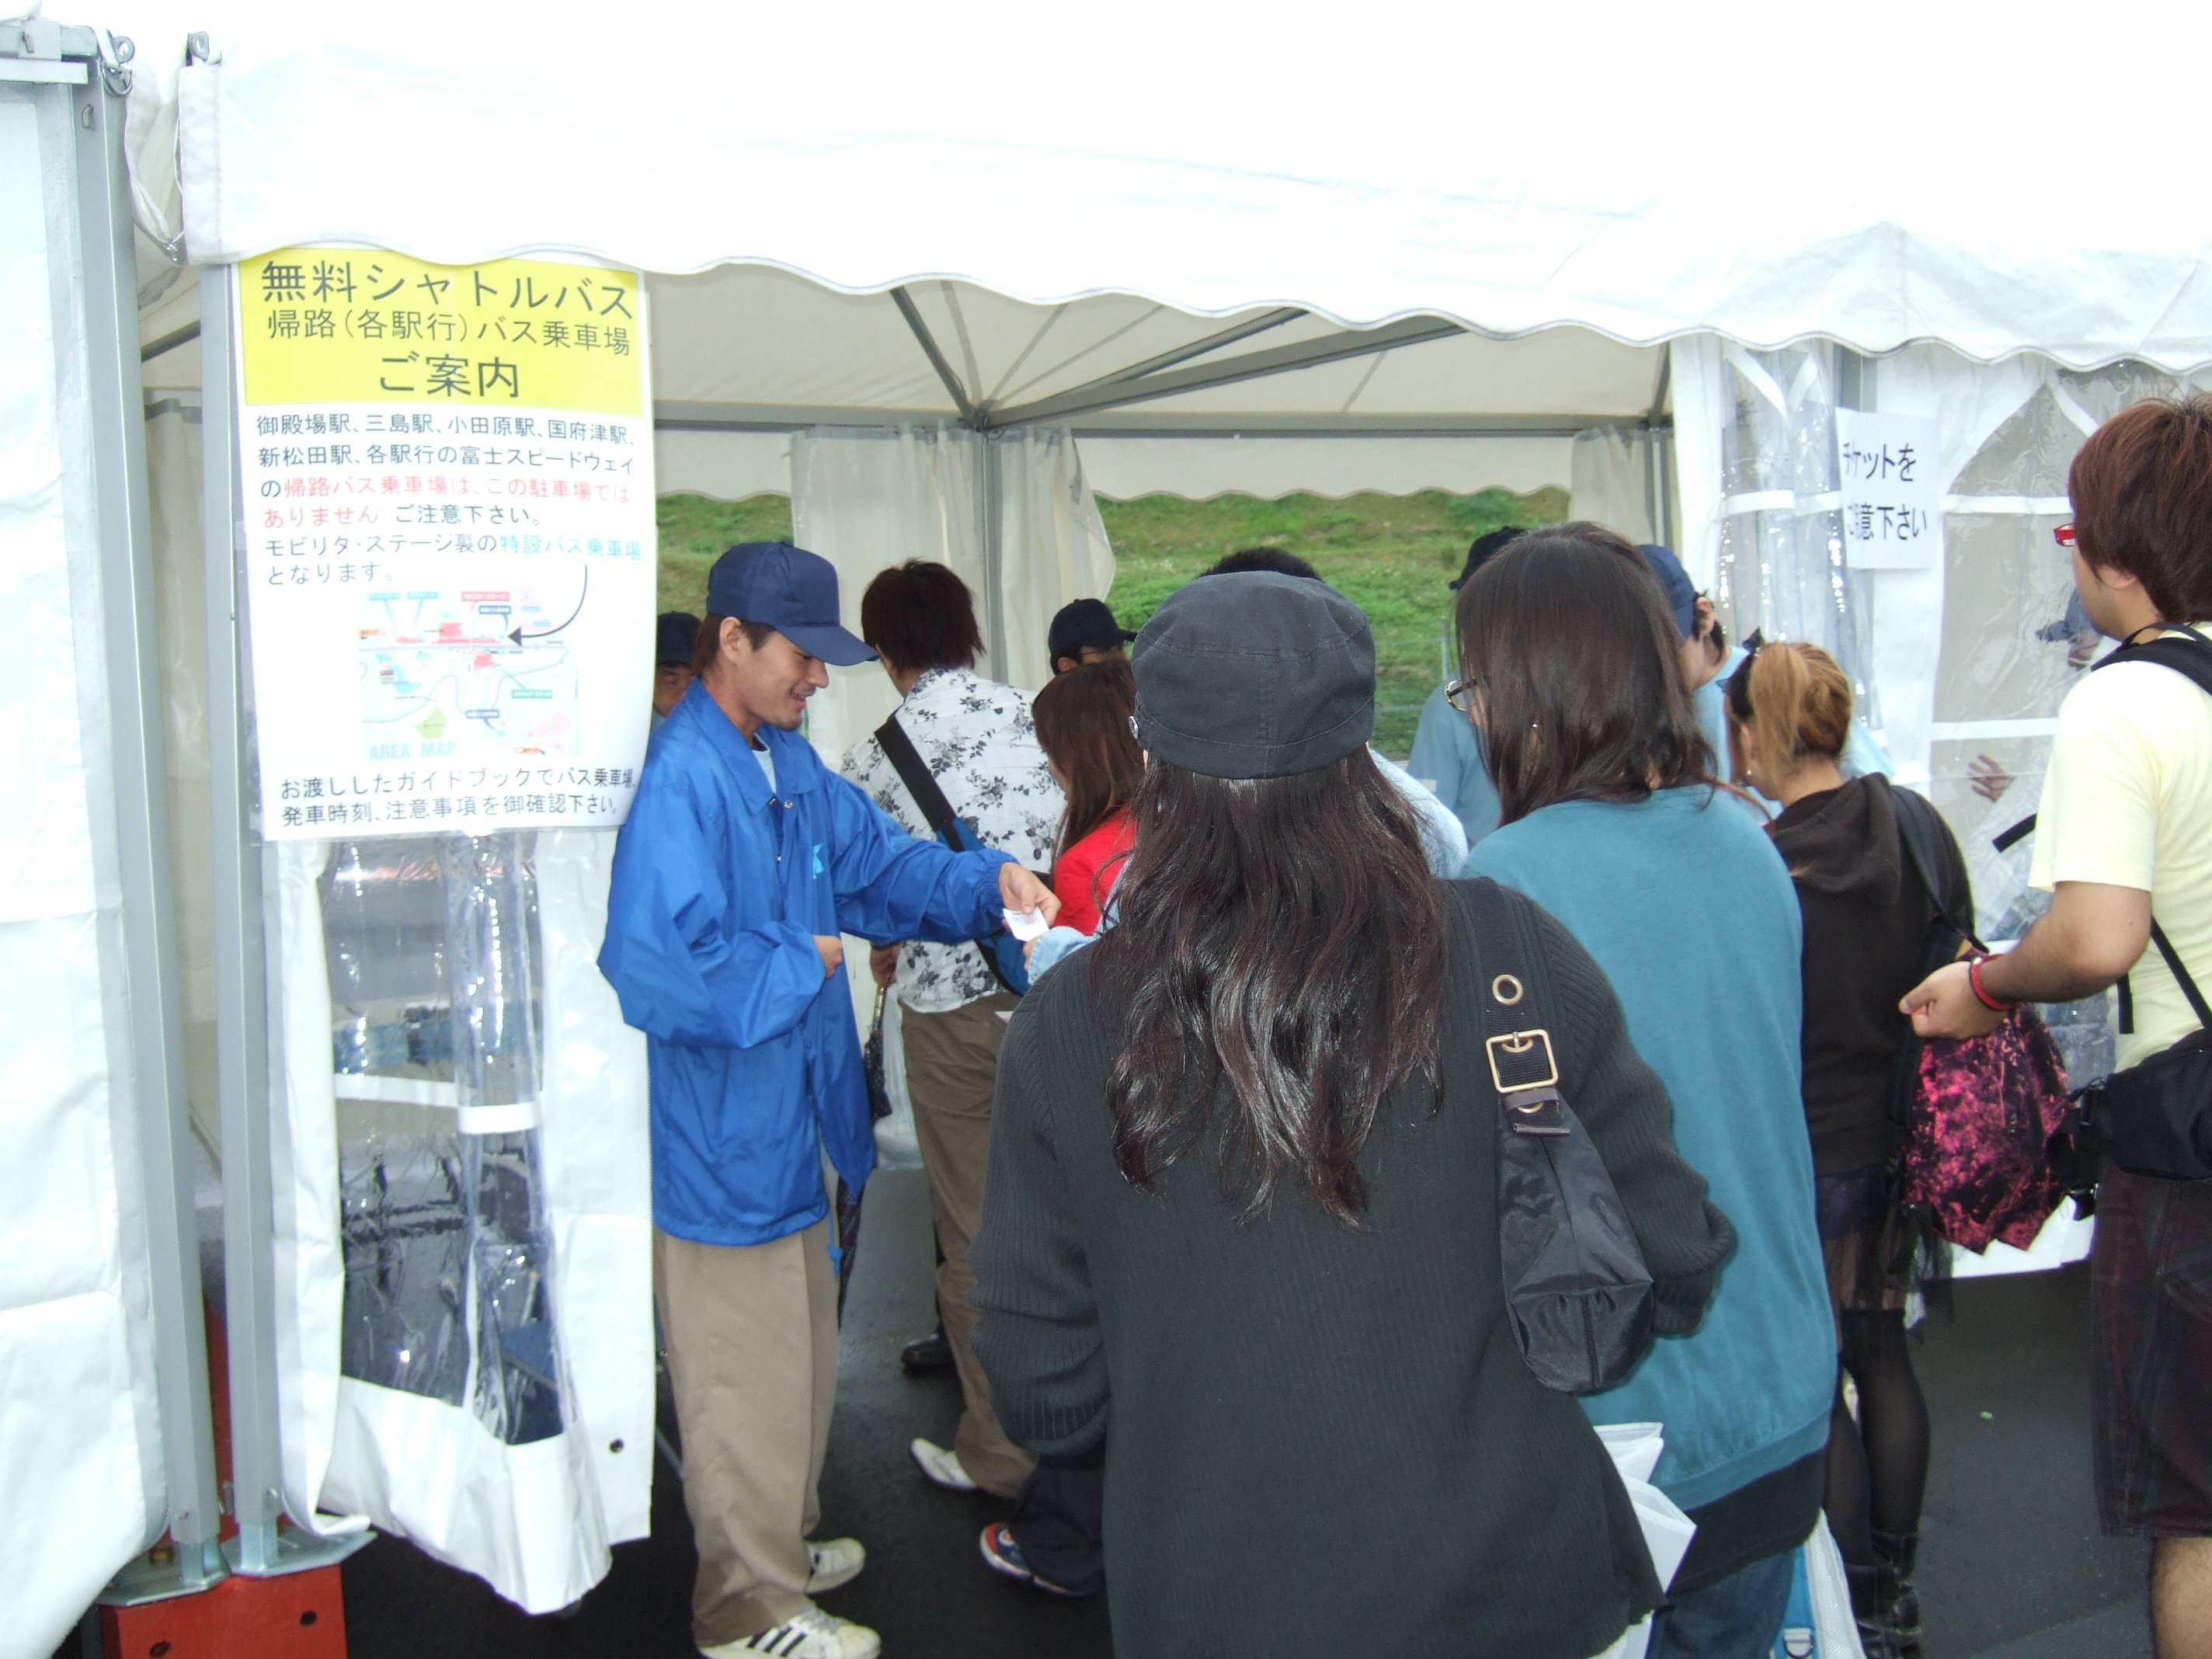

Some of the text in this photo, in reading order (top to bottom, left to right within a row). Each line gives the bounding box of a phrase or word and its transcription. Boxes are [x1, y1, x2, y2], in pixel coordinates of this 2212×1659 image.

[261, 259, 634, 319] 無料シャトルバス
[379, 350, 520, 398] ご案内
[267, 562, 392, 586] となります。
[369, 740, 458, 760] AREA MAP
